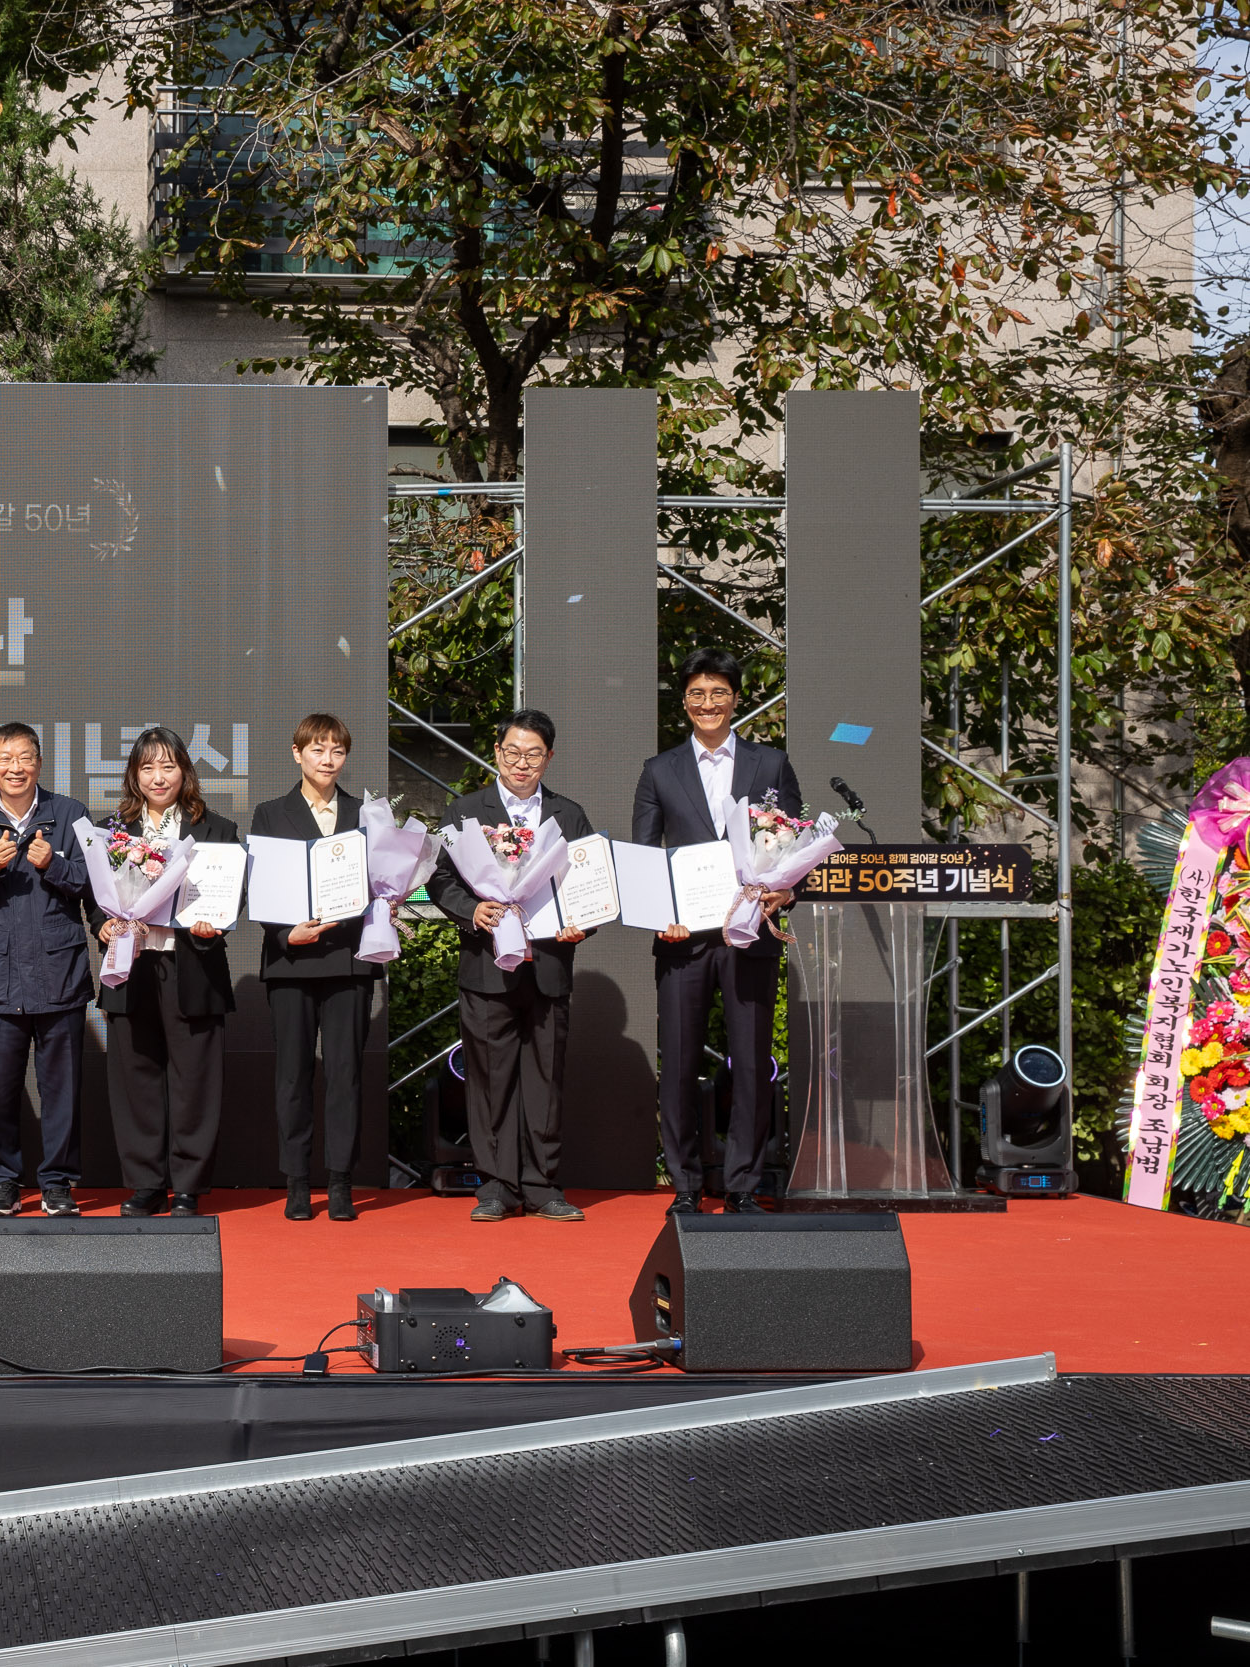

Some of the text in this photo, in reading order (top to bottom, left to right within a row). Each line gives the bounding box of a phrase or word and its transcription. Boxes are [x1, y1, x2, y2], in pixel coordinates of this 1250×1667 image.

[25, 503, 91, 533] 50년
[830, 853, 859, 865] 걸어온
[860, 853, 887, 865] 50년,
[889, 853, 909, 865] 함께
[910, 853, 939, 865] 걸어갈
[940, 853, 964, 864] 50년
[801, 866, 1014, 893] 회관 50주년 기념식
[1143, 1074, 1174, 1111] 회장
